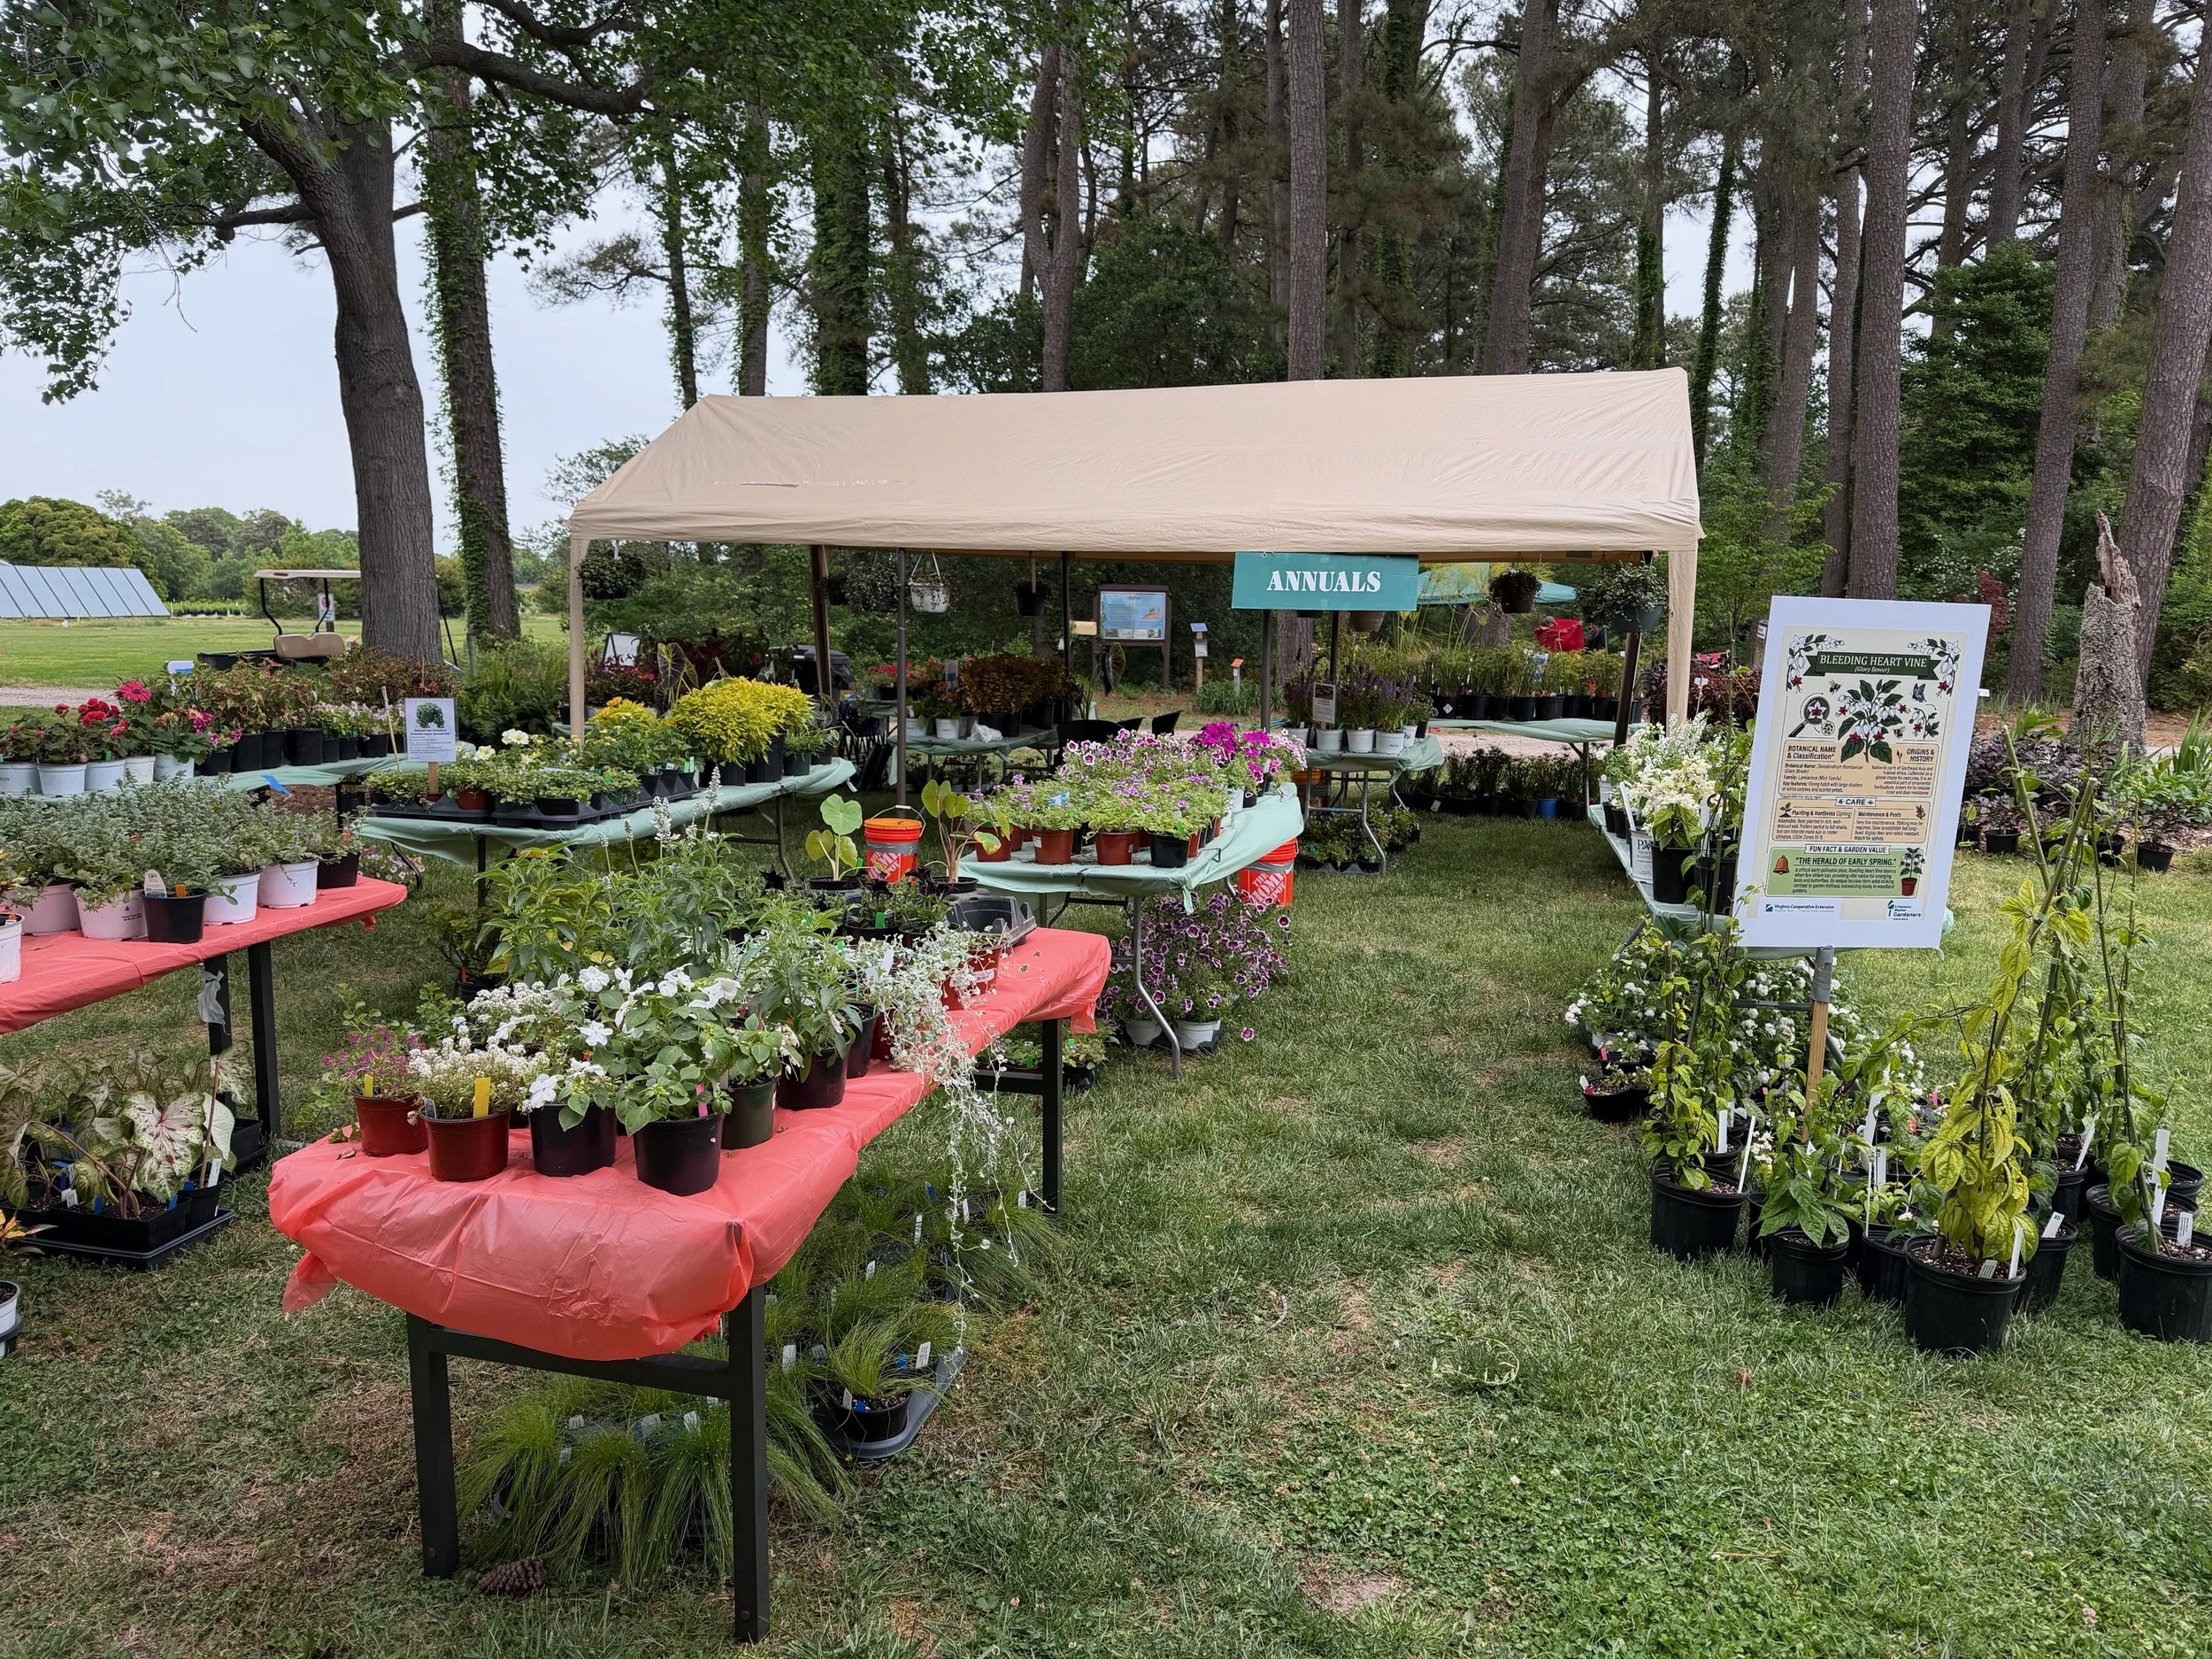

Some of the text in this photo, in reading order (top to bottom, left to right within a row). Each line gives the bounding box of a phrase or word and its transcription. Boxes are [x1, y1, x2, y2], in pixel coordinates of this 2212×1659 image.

[1266, 570, 1381, 593] ANNUALS
[1820, 655, 1927, 667] BLEEDING HEART VINE
[1252, 872, 1269, 887] THE
